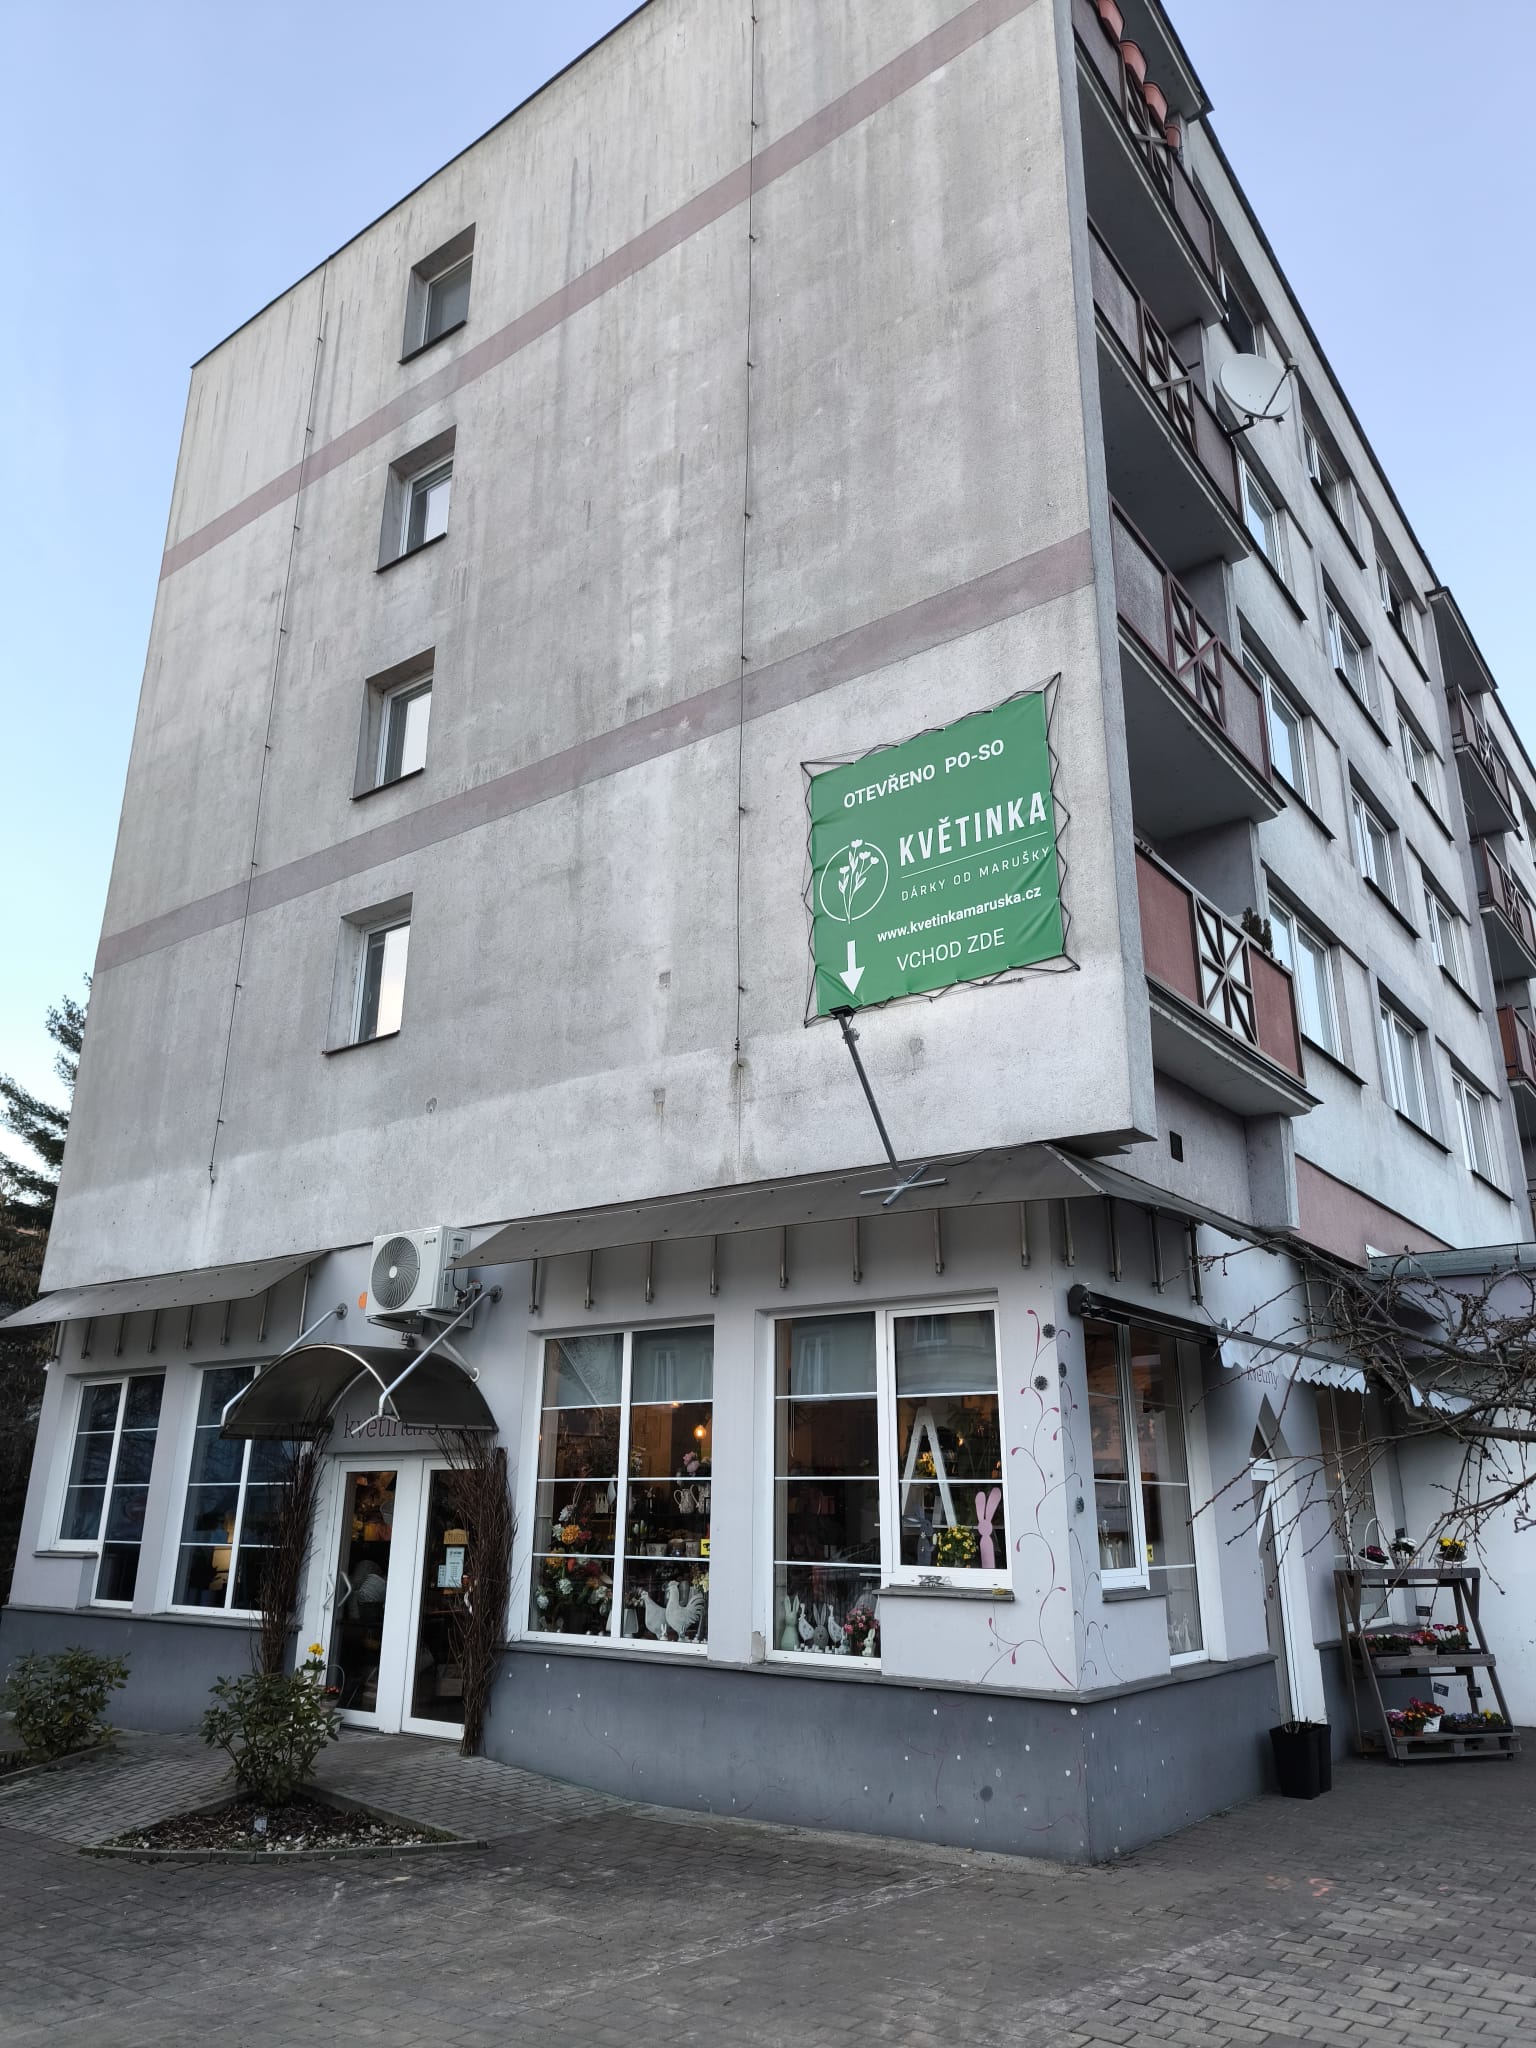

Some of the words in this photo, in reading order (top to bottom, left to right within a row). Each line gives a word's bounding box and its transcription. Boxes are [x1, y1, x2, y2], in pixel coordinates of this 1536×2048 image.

[844, 765, 935, 808] OTEVŘENO
[945, 740, 1004, 773] PO-SO
[900, 792, 1046, 866] KVĚTINKA
[902, 879, 945, 901] DÁRKY
[954, 872, 971, 886] OD
[980, 847, 1049, 877] MARUŠKY
[877, 887, 1041, 942] www.kvetinkamaruska.cz
[897, 941, 961, 971] VCHOD
[968, 928, 1005, 953] ZDE
